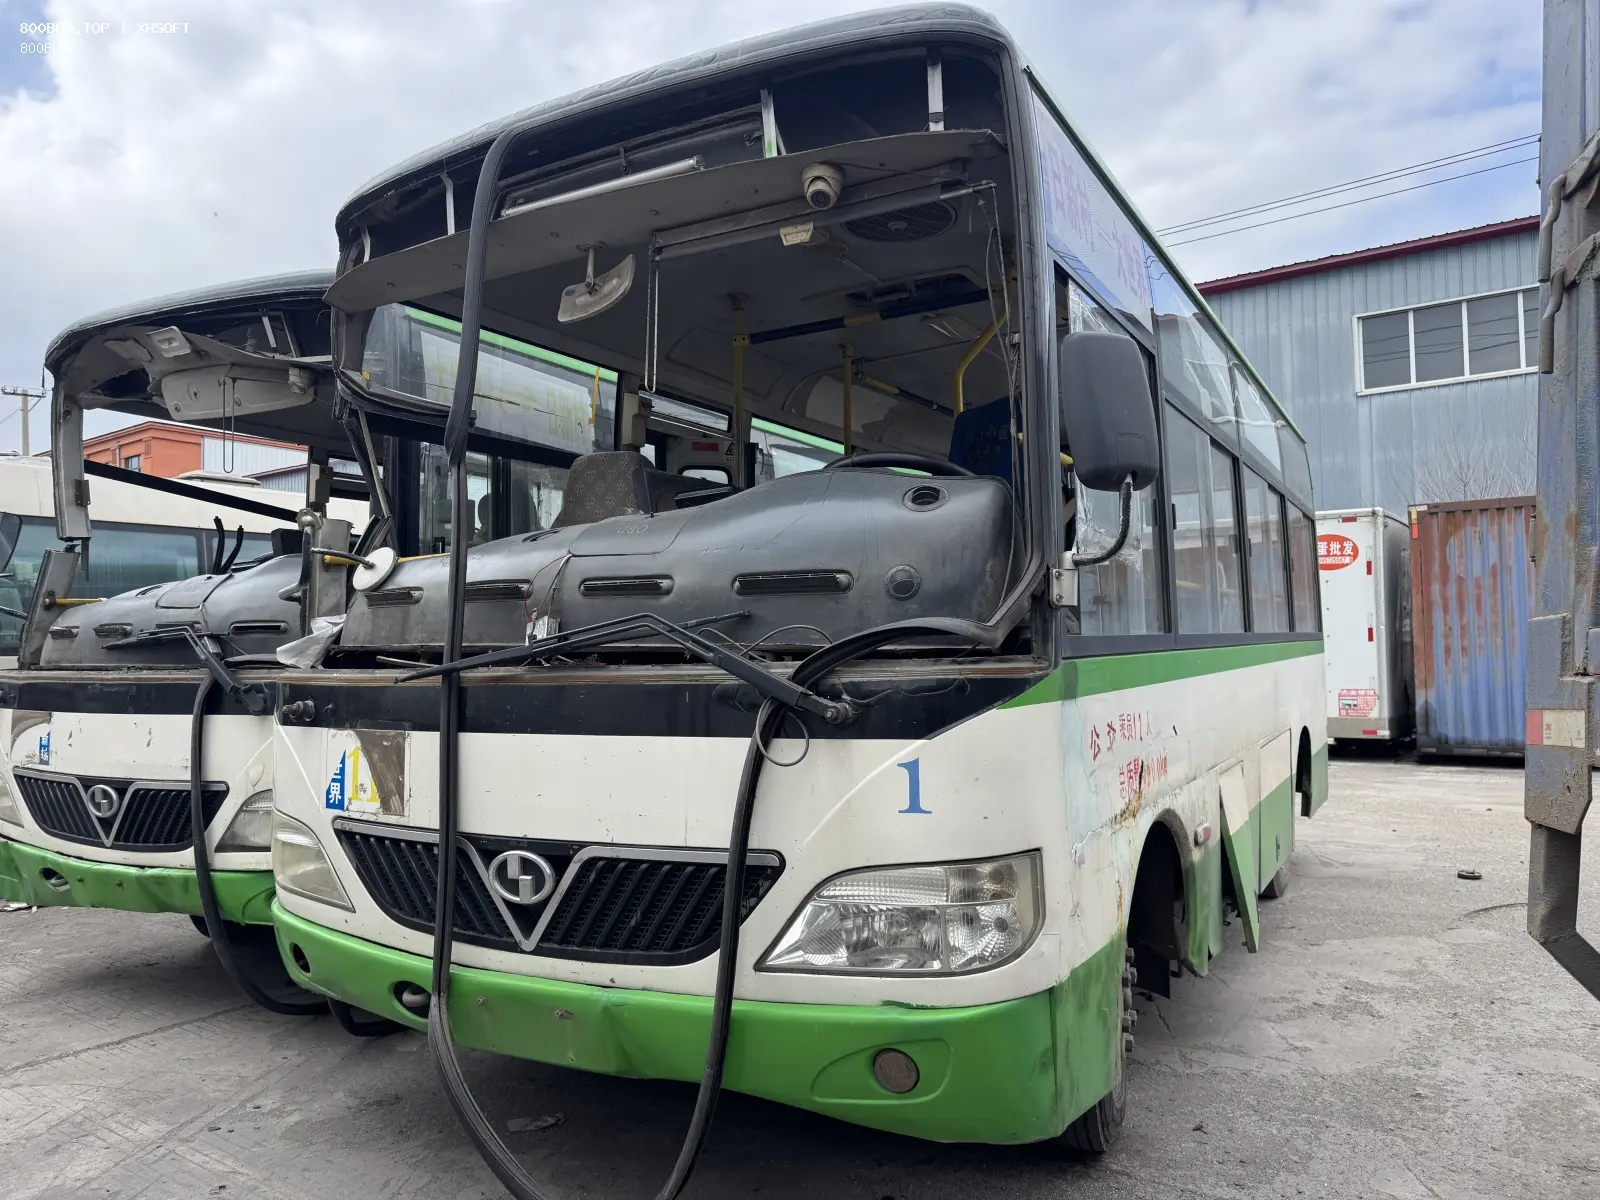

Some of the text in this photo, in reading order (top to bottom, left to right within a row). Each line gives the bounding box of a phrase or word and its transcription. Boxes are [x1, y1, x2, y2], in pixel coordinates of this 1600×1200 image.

[1318, 541, 1354, 556] 蛋批发
[896, 757, 933, 815] 1
